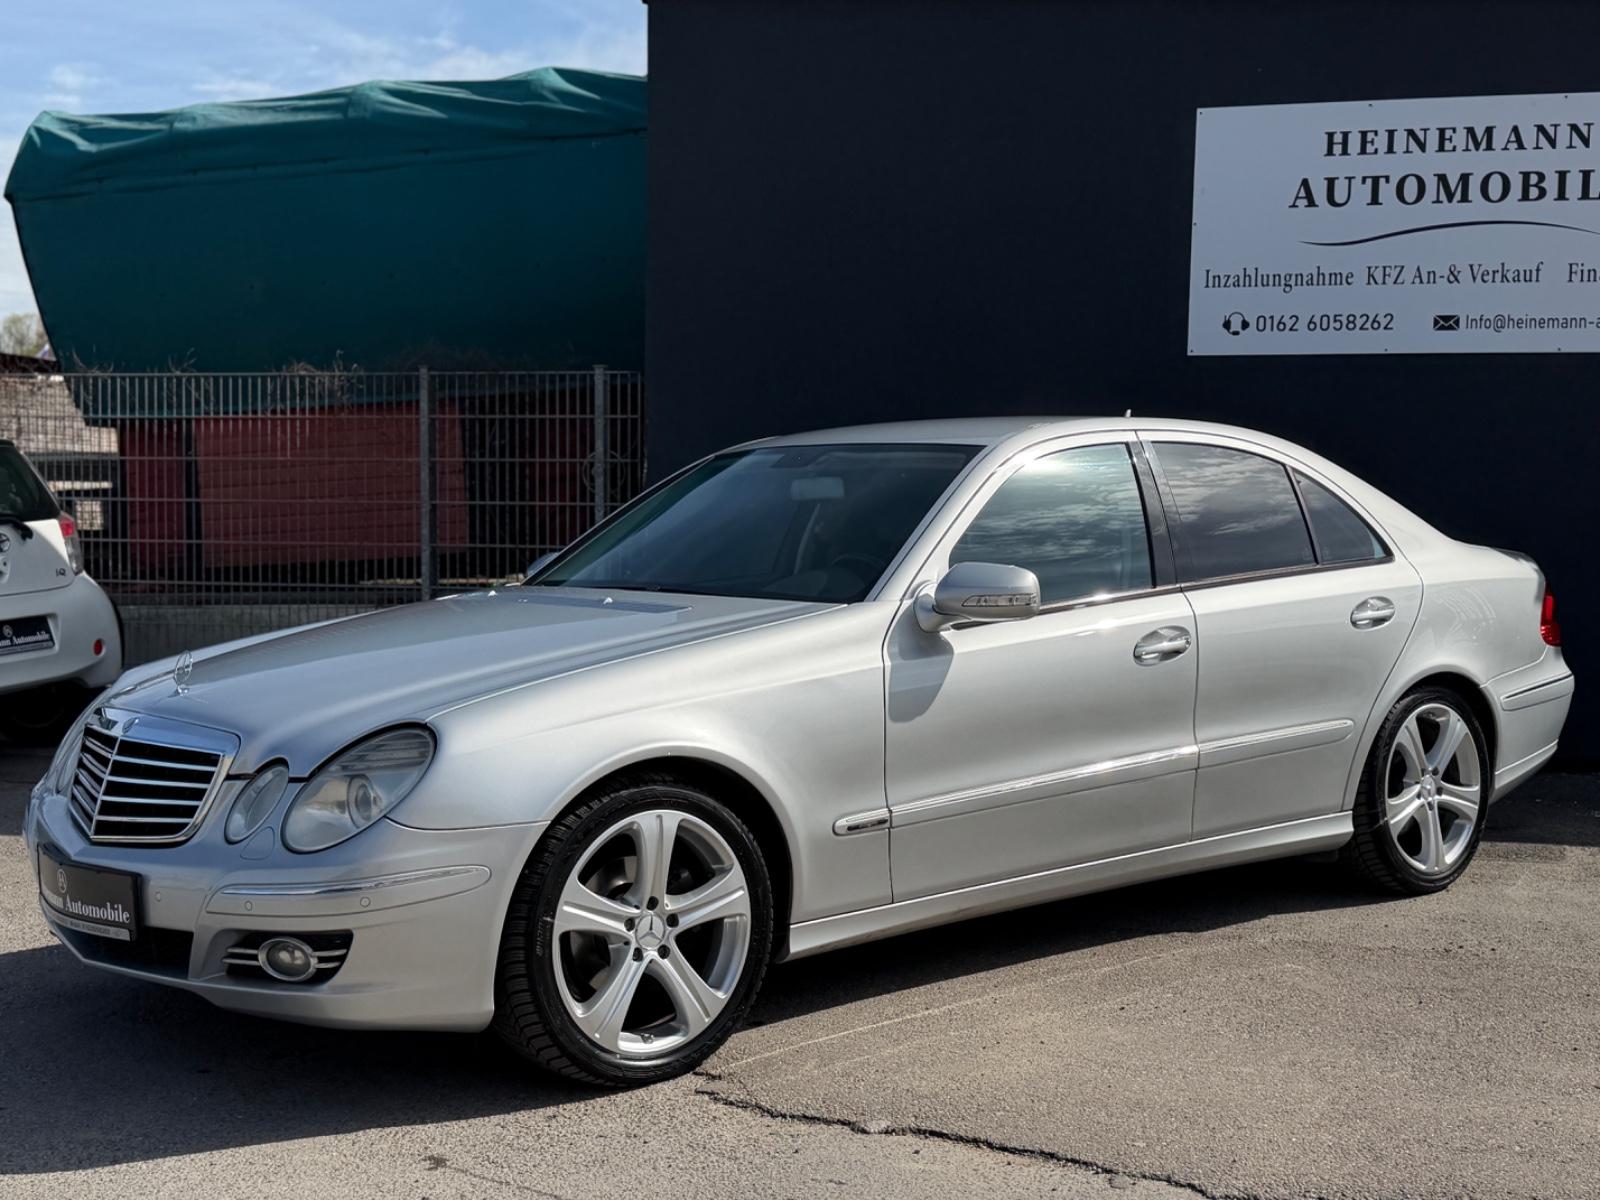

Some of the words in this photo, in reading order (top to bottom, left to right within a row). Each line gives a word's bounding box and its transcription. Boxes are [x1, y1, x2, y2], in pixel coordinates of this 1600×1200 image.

[1323, 122, 1595, 157] HEINEMANN
[1288, 169, 1600, 208] AUTOMOBIL
[1203, 265, 1355, 294] Inzahlungnahme
[1366, 265, 1406, 286] KFZ
[1468, 260, 1544, 284] Verkauf
[1567, 262, 1600, 283] Fin
[1255, 314, 1300, 332] 0162
[1306, 312, 1395, 332] 6058262
[66, 893, 130, 923] Automobile
